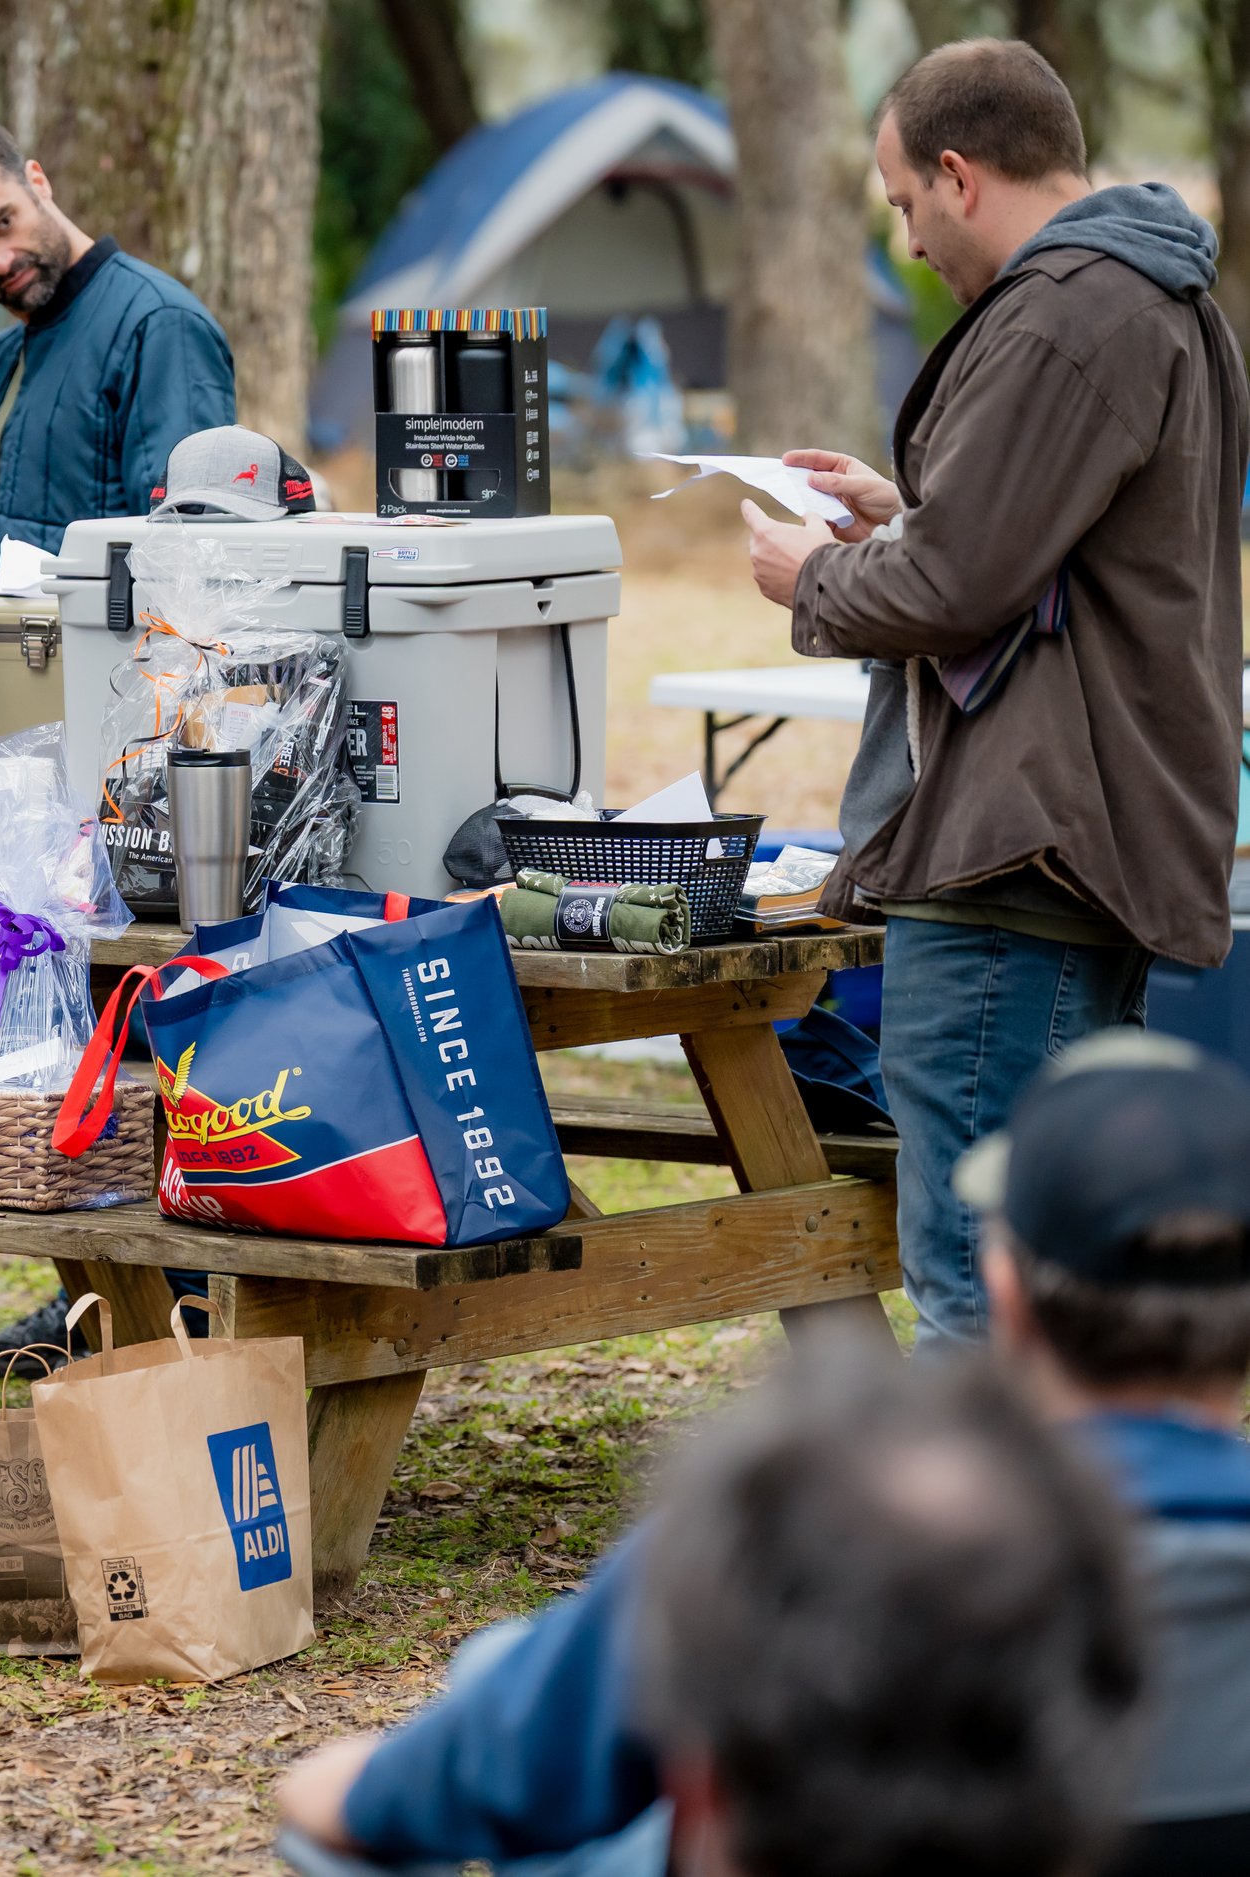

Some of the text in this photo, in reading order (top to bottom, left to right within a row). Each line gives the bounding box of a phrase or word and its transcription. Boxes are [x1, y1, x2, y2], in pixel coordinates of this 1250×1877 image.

[405, 442, 430, 450] Stainless
[430, 442, 445, 450] Steel
[463, 442, 485, 450] Bottles
[414, 434, 476, 442] Insulated Wide Mouth
[380, 504, 407, 514] 2 Pack
[382, 706, 394, 719] 48
[279, 741, 295, 767] FREE
[157, 830, 173, 853] B
[128, 851, 173, 865] The American
[401, 967, 428, 1043] THOROGOODUSA.COM
[416, 957, 477, 1092] SINCE
[212, 1145, 260, 1165] 1892
[456, 1105, 516, 1209] 1892
[160, 1157, 190, 1213] ACE
[186, 1195, 226, 1220] UP
[243, 1523, 285, 1562] ALDI
[113, 1604, 136, 1612] PAPER
[118, 1612, 134, 1620] BAG
